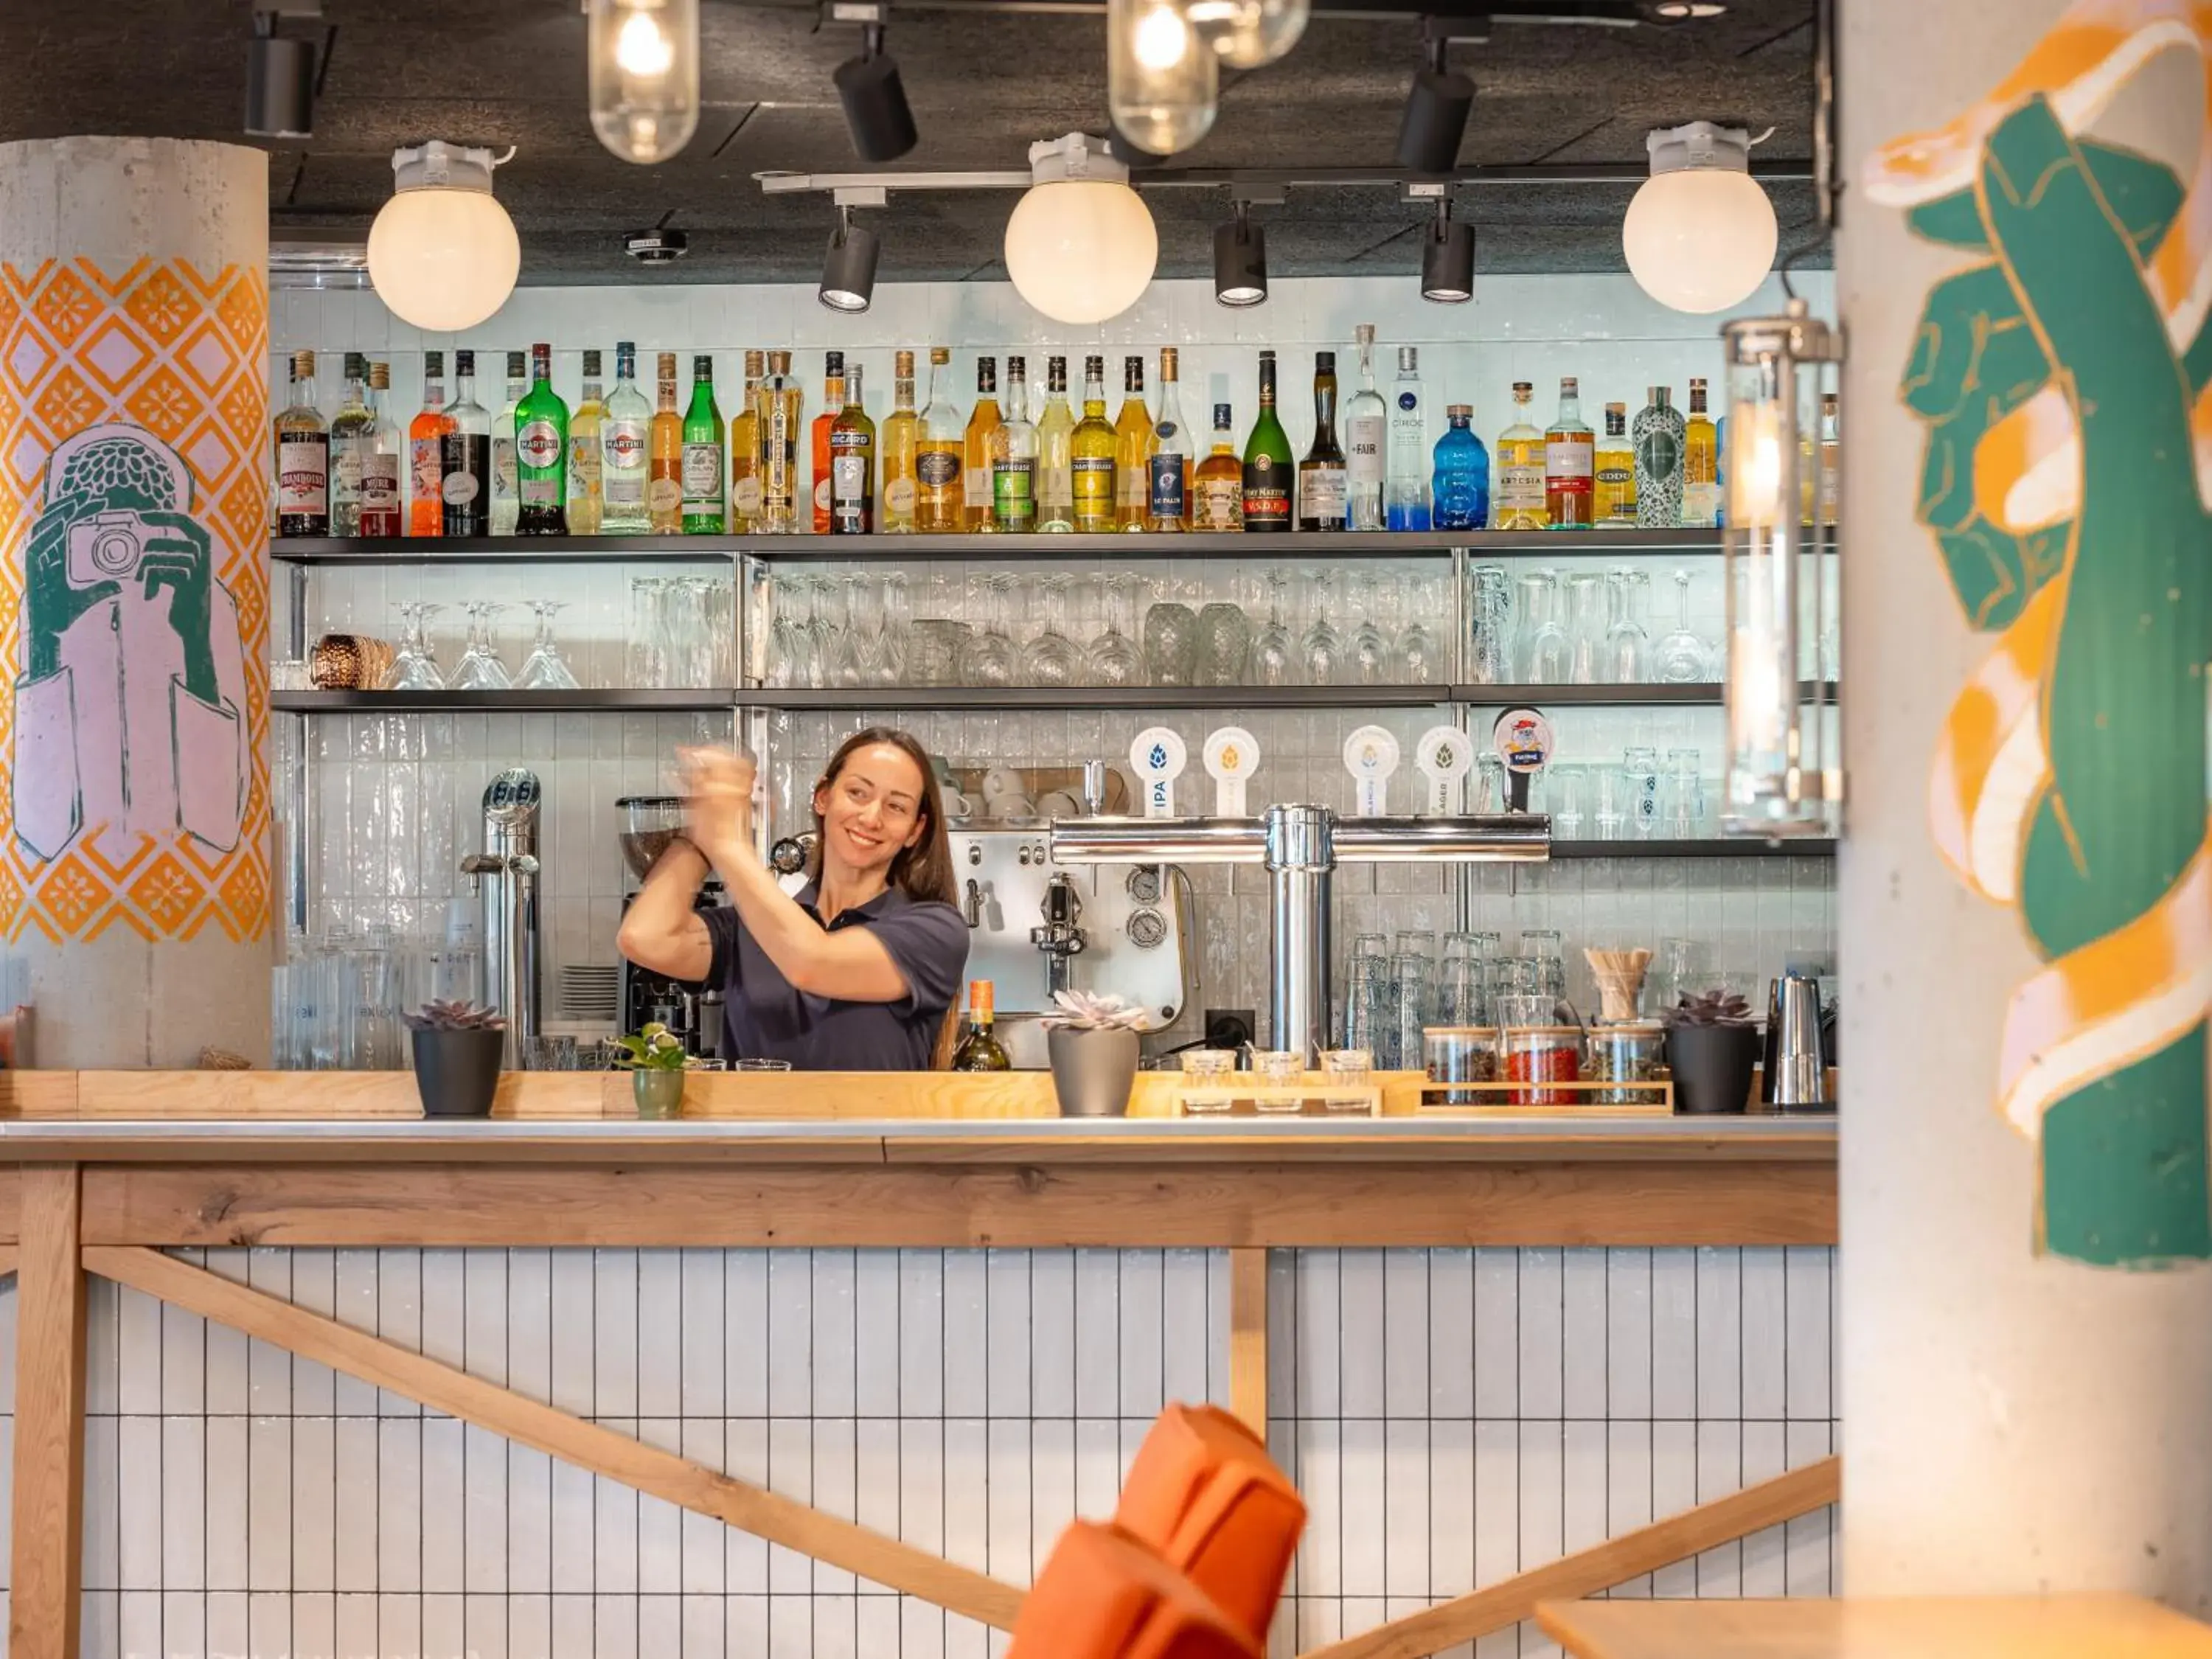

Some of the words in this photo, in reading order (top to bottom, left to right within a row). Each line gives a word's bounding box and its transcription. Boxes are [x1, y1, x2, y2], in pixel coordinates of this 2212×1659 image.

[832, 435, 868, 444] RICARD
[521, 440, 557, 449] MARTINI
[607, 440, 643, 449] MARTINI
[1154, 781, 1166, 807] IPA
